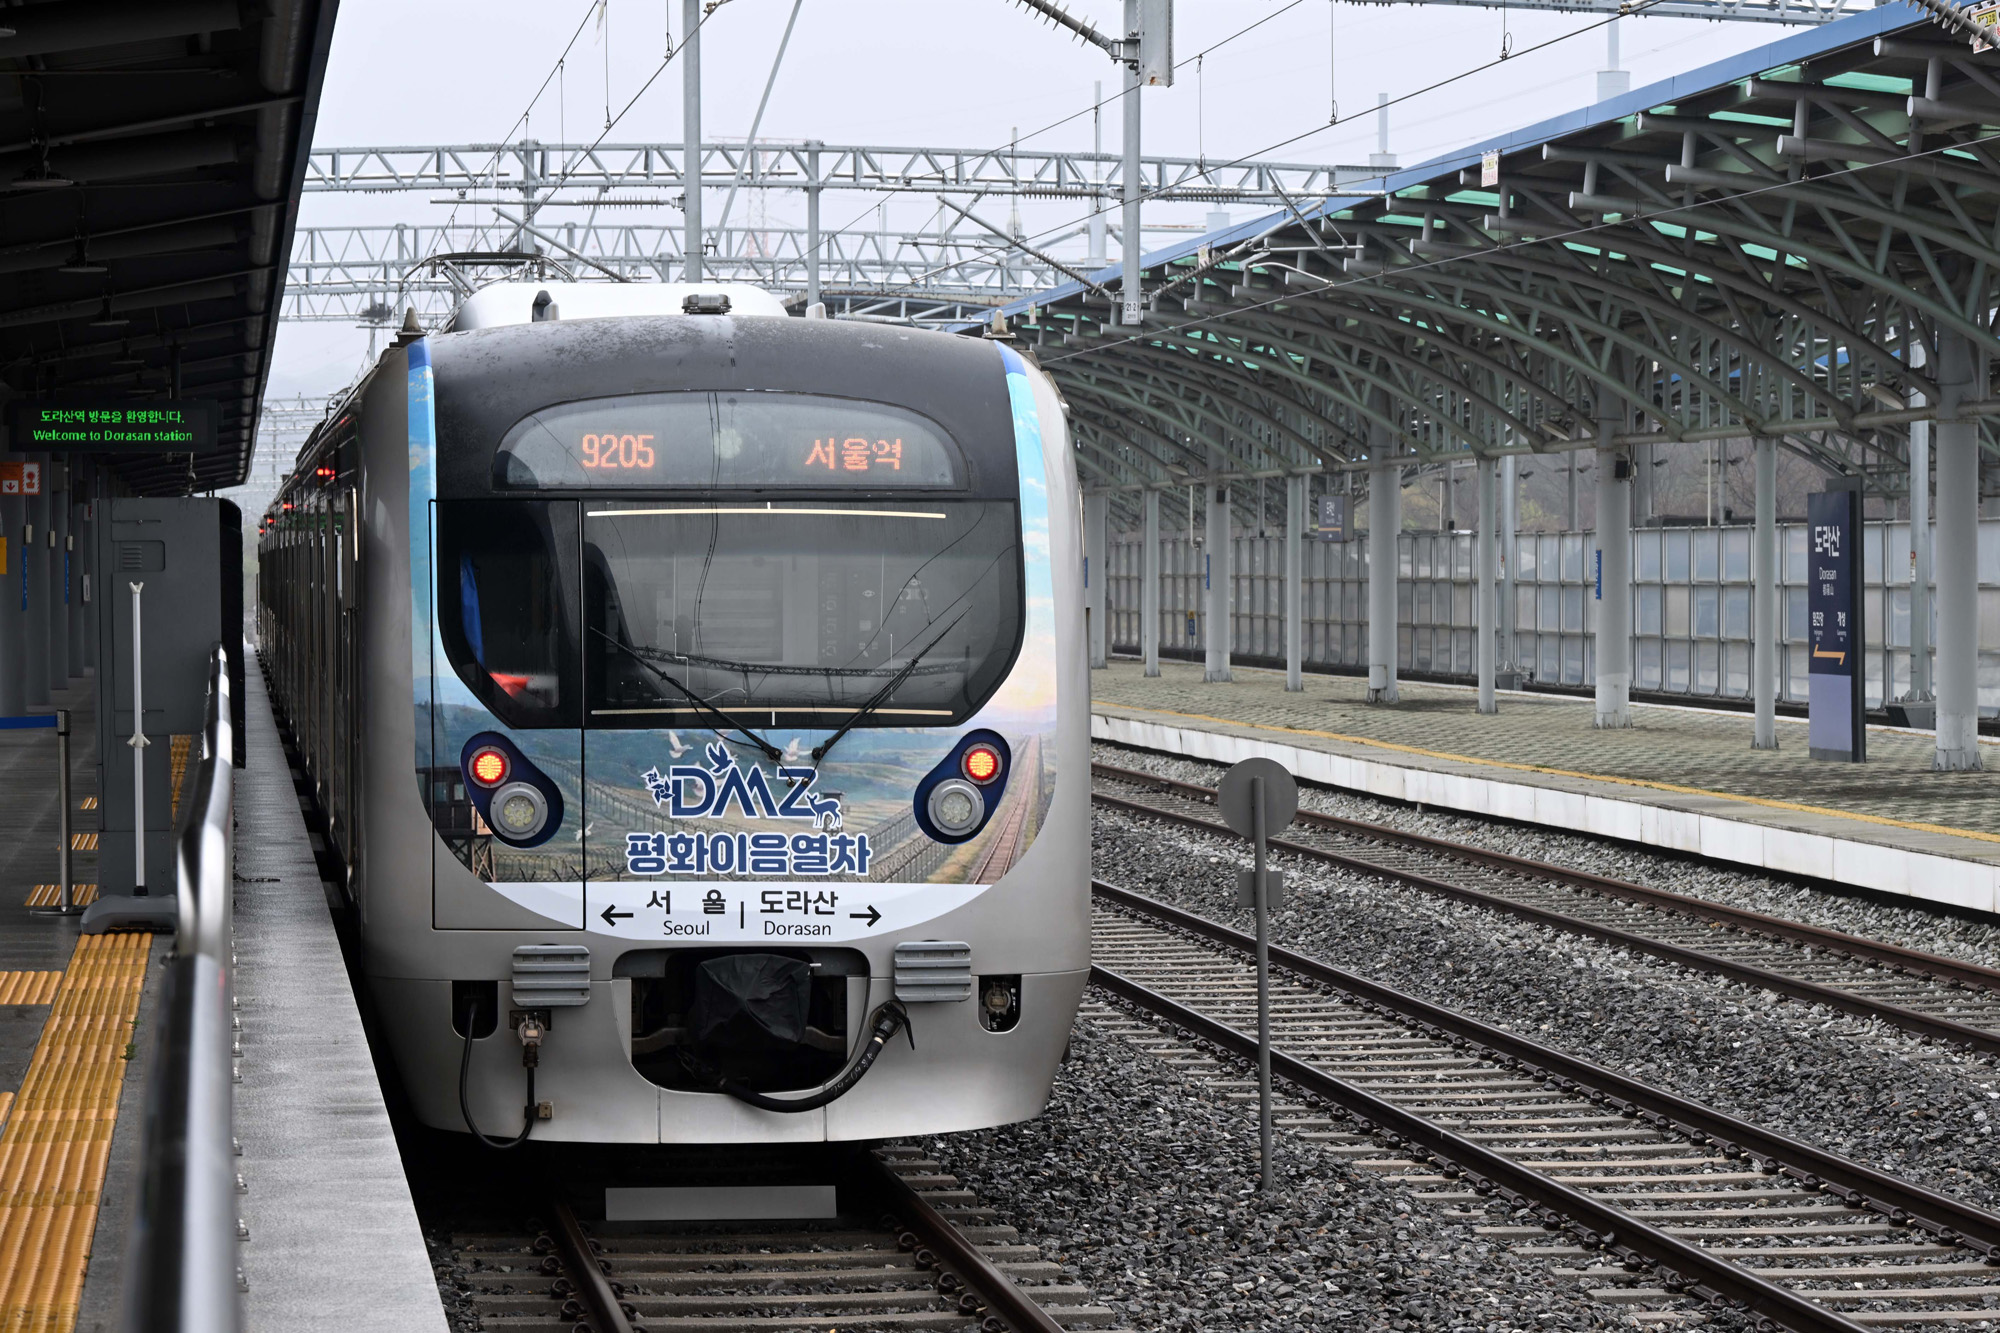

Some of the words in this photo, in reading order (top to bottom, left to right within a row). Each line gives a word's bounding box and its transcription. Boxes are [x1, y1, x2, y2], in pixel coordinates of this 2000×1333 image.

[40, 410, 85, 423] 도라산역
[88, 410, 122, 424] 방문을
[126, 410, 185, 424] 환영합니다.
[33, 429, 87, 441] Welcome
[89, 430, 101, 441] to
[104, 430, 152, 441] Dorasan
[154, 429, 193, 441] station
[582, 434, 655, 468] 9205
[805, 437, 903, 471] 서울역
[1814, 525, 1841, 557] 도라산
[669, 765, 818, 819] DMZ
[625, 831, 873, 876] 평화이음열차
[760, 890, 839, 915] 도라산
[663, 920, 710, 936] Seoul
[764, 920, 832, 936] Dorasan
